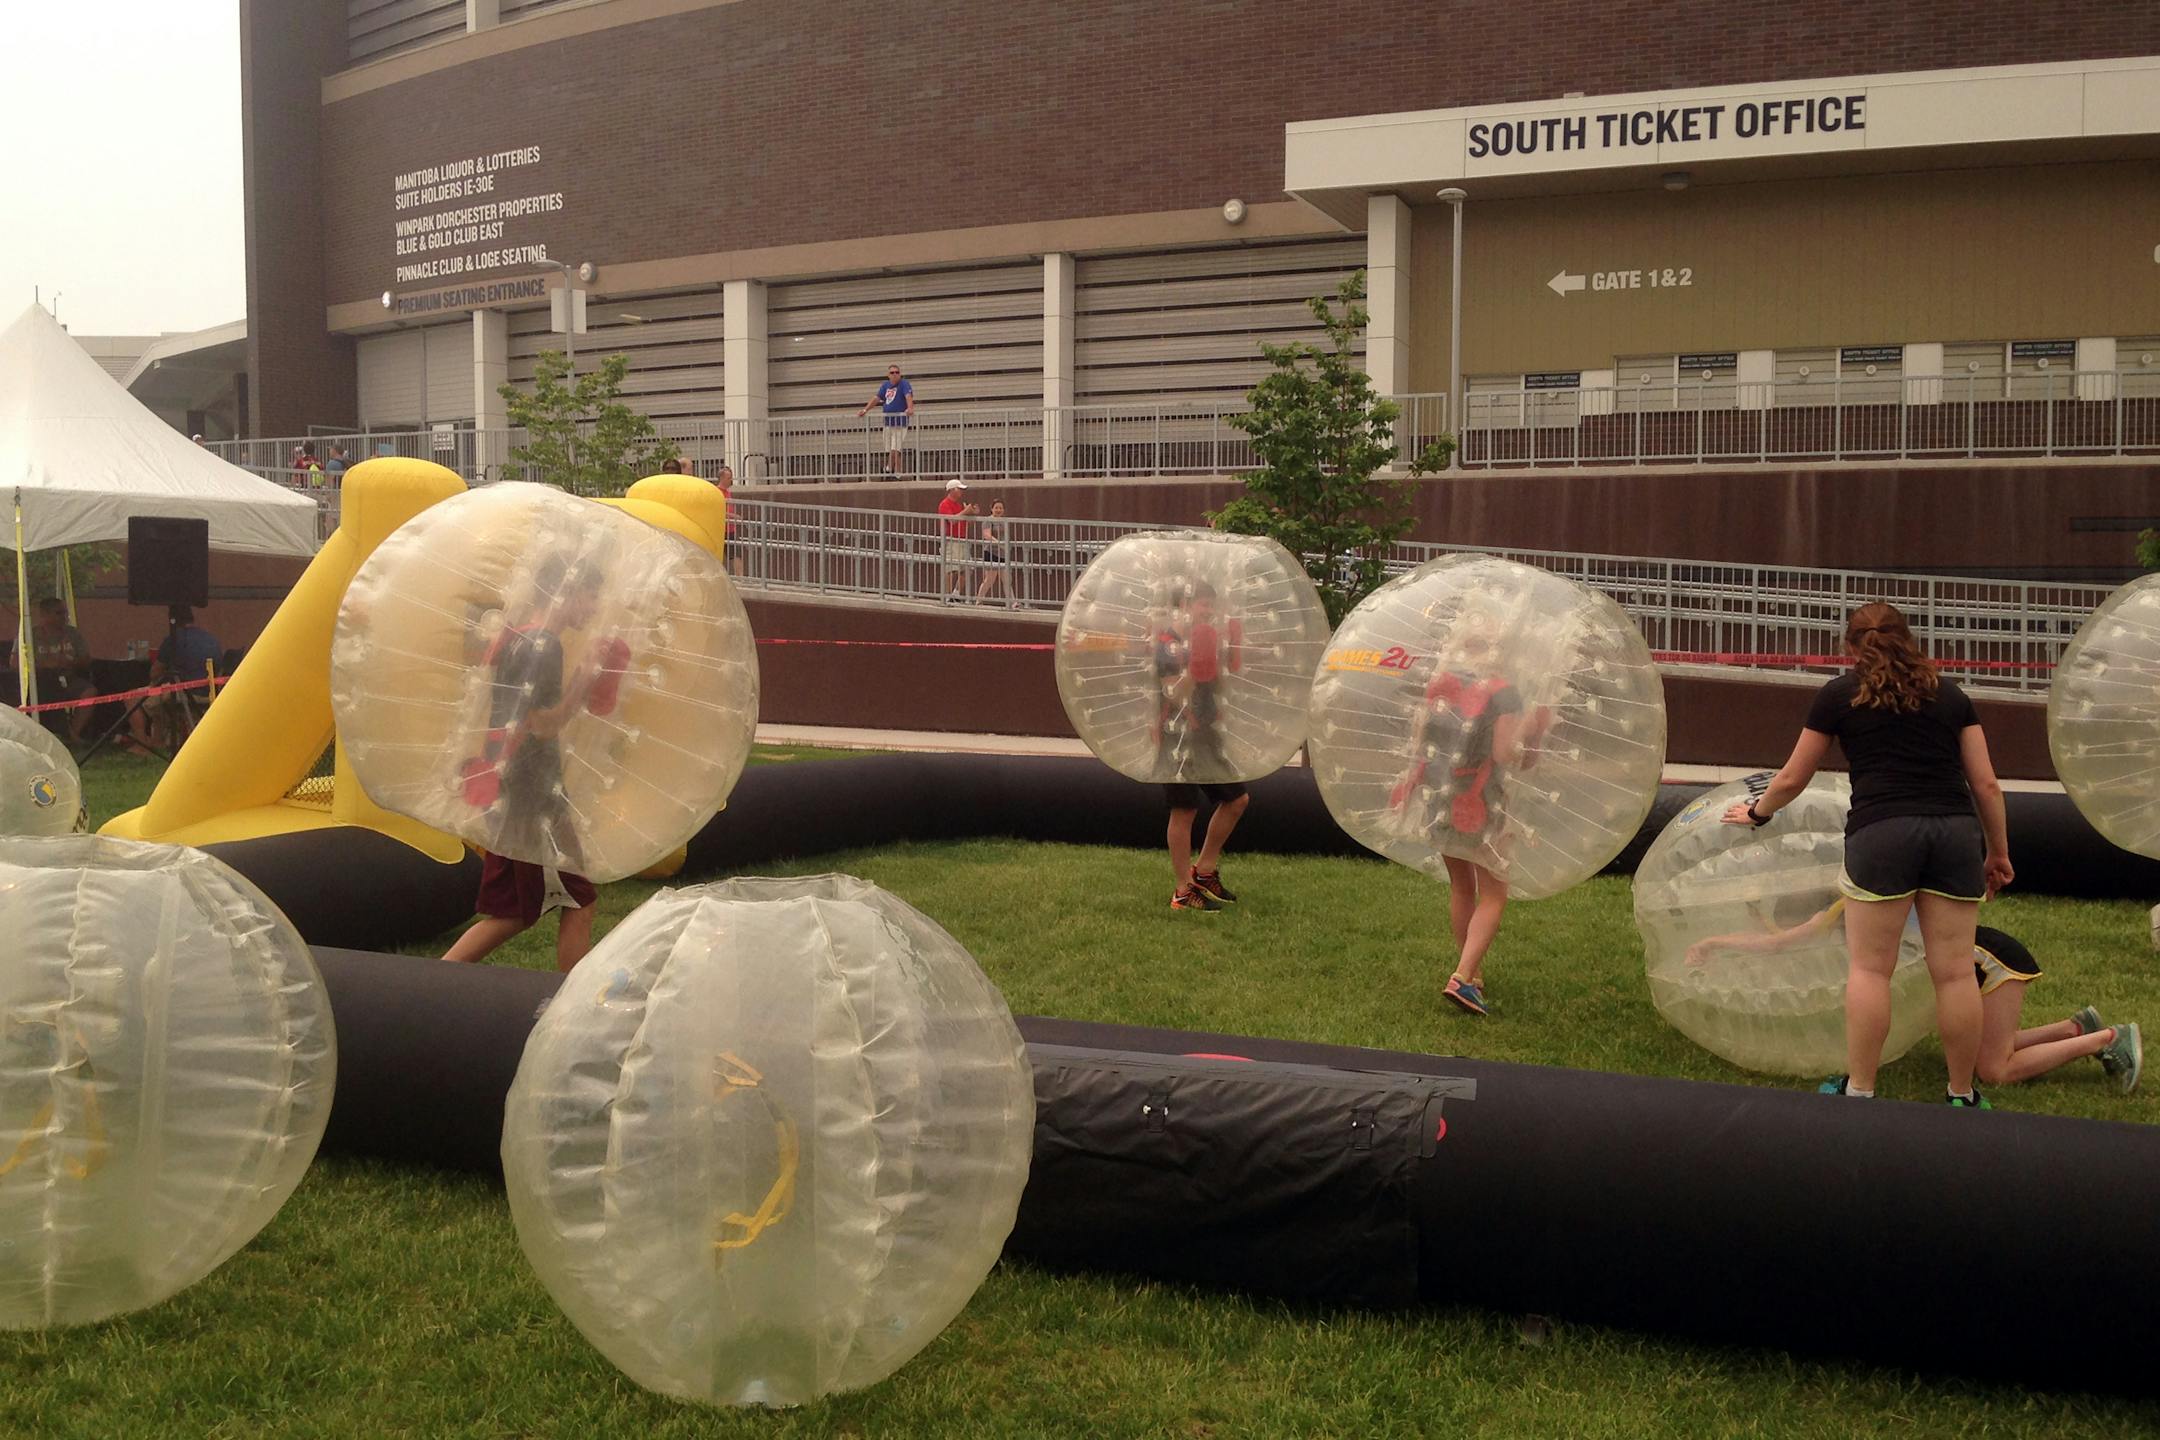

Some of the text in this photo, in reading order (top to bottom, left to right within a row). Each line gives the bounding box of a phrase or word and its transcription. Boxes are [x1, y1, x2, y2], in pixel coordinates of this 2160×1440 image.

[1468, 96, 1866, 158] SOUTH TICKET OFFICE
[395, 146, 540, 191] MANITOBA LIQUOR & LOTTERIES
[395, 191, 420, 210] SUITE
[421, 181, 462, 204] HOLDERS
[396, 193, 563, 237] WINPARK DORCHESTER PROPERTIES
[396, 221, 504, 255] BLUE & GOLD CLUB EAST
[396, 244, 546, 283] PINNACLE CLUB & LOGE SEATING
[1591, 268, 1692, 291] GATE 1&2
[398, 278, 545, 314] PREMIUM SEATING ENTRANCE
